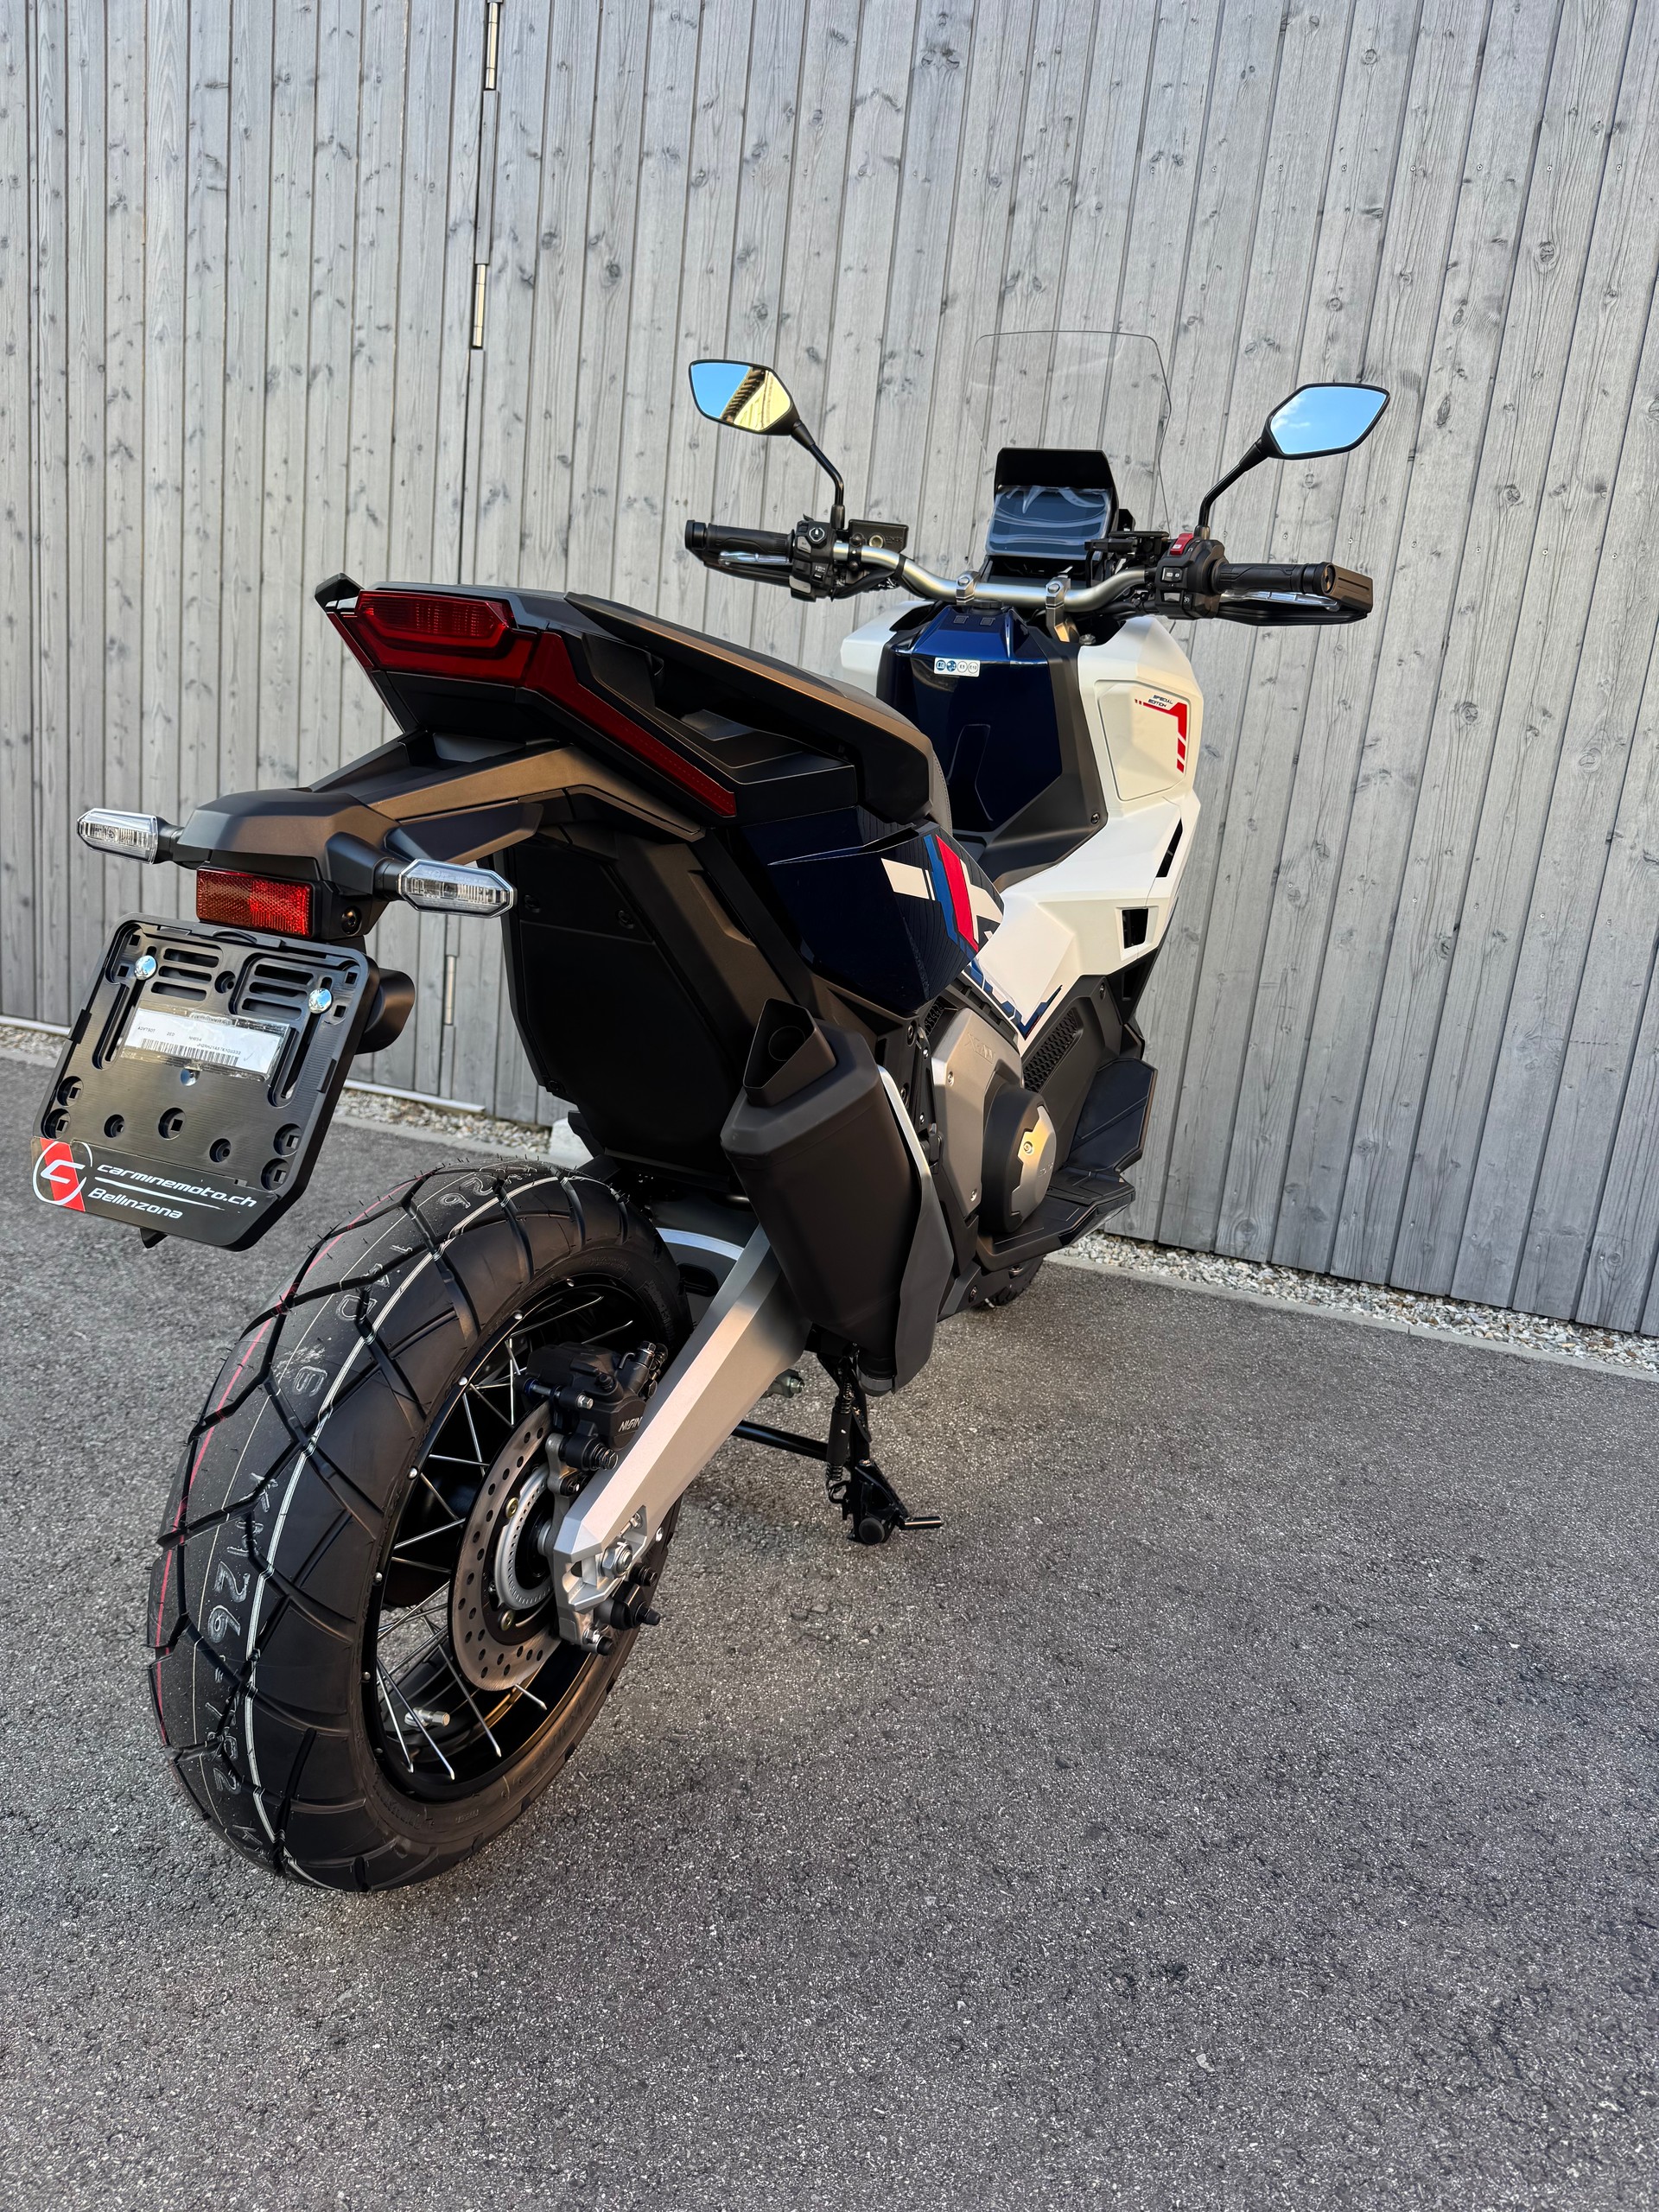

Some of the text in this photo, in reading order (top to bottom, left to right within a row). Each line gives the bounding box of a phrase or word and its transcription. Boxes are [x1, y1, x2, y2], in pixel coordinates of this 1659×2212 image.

[1147, 698, 1166, 707] EDITION
[1153, 695, 1173, 704] SPECIAL
[97, 1163, 257, 1208] carminemoto.ch
[87, 1187, 183, 1219] Bellinzona
